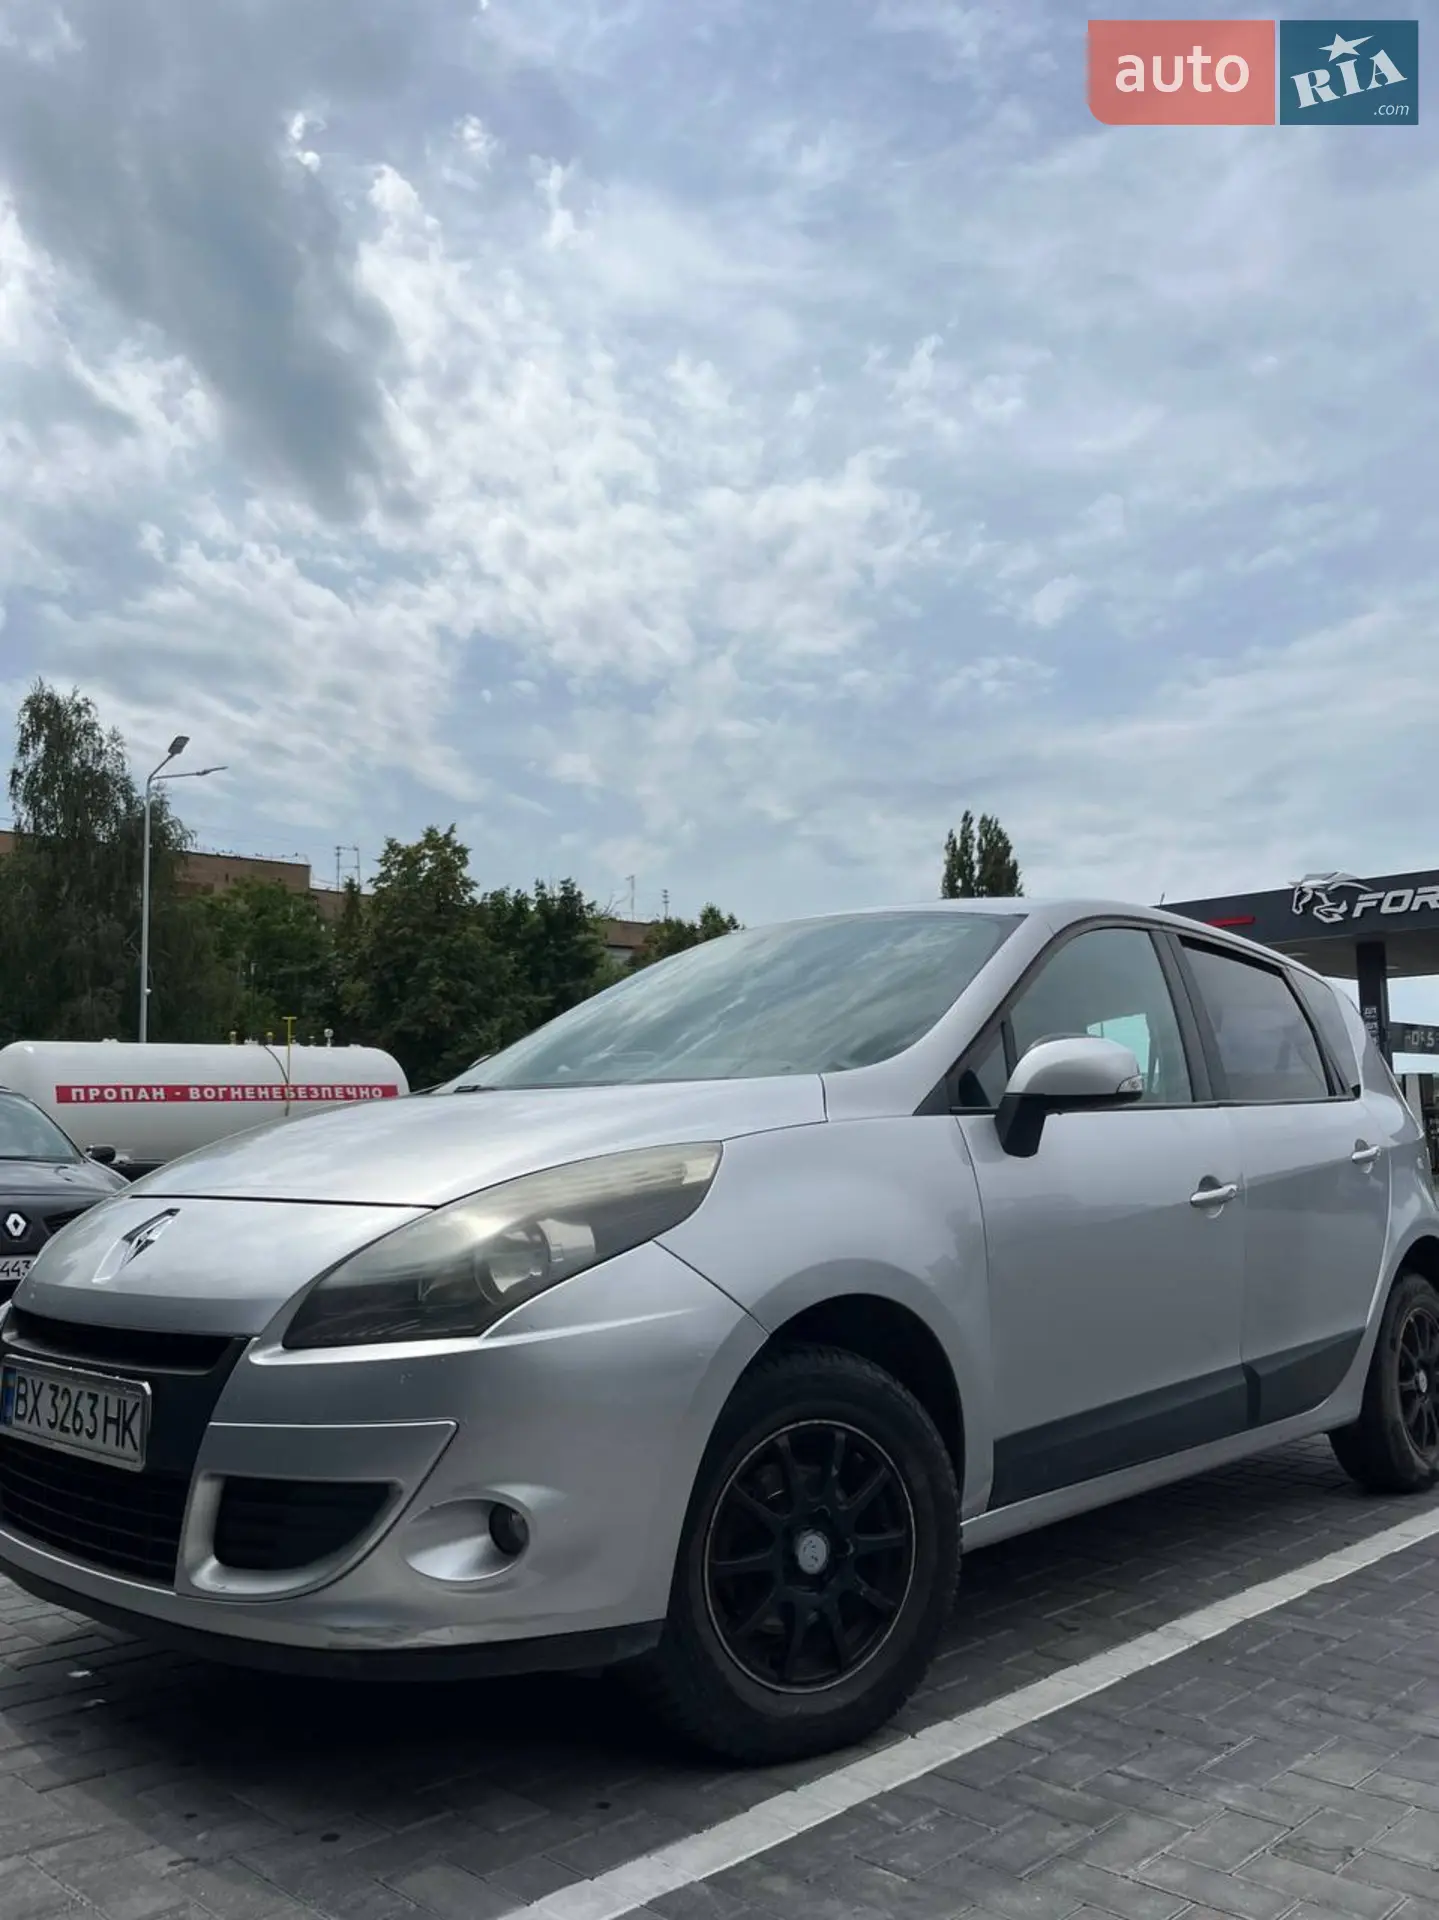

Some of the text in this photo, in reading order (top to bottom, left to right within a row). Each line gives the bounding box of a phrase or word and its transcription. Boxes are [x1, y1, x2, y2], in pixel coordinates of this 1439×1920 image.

[71, 1087, 166, 1101] ПРОПАН
[188, 1086, 383, 1100] ВОГНЕНЕБЕЗПЕЧНО
[47, 1382, 99, 1440] 3263
